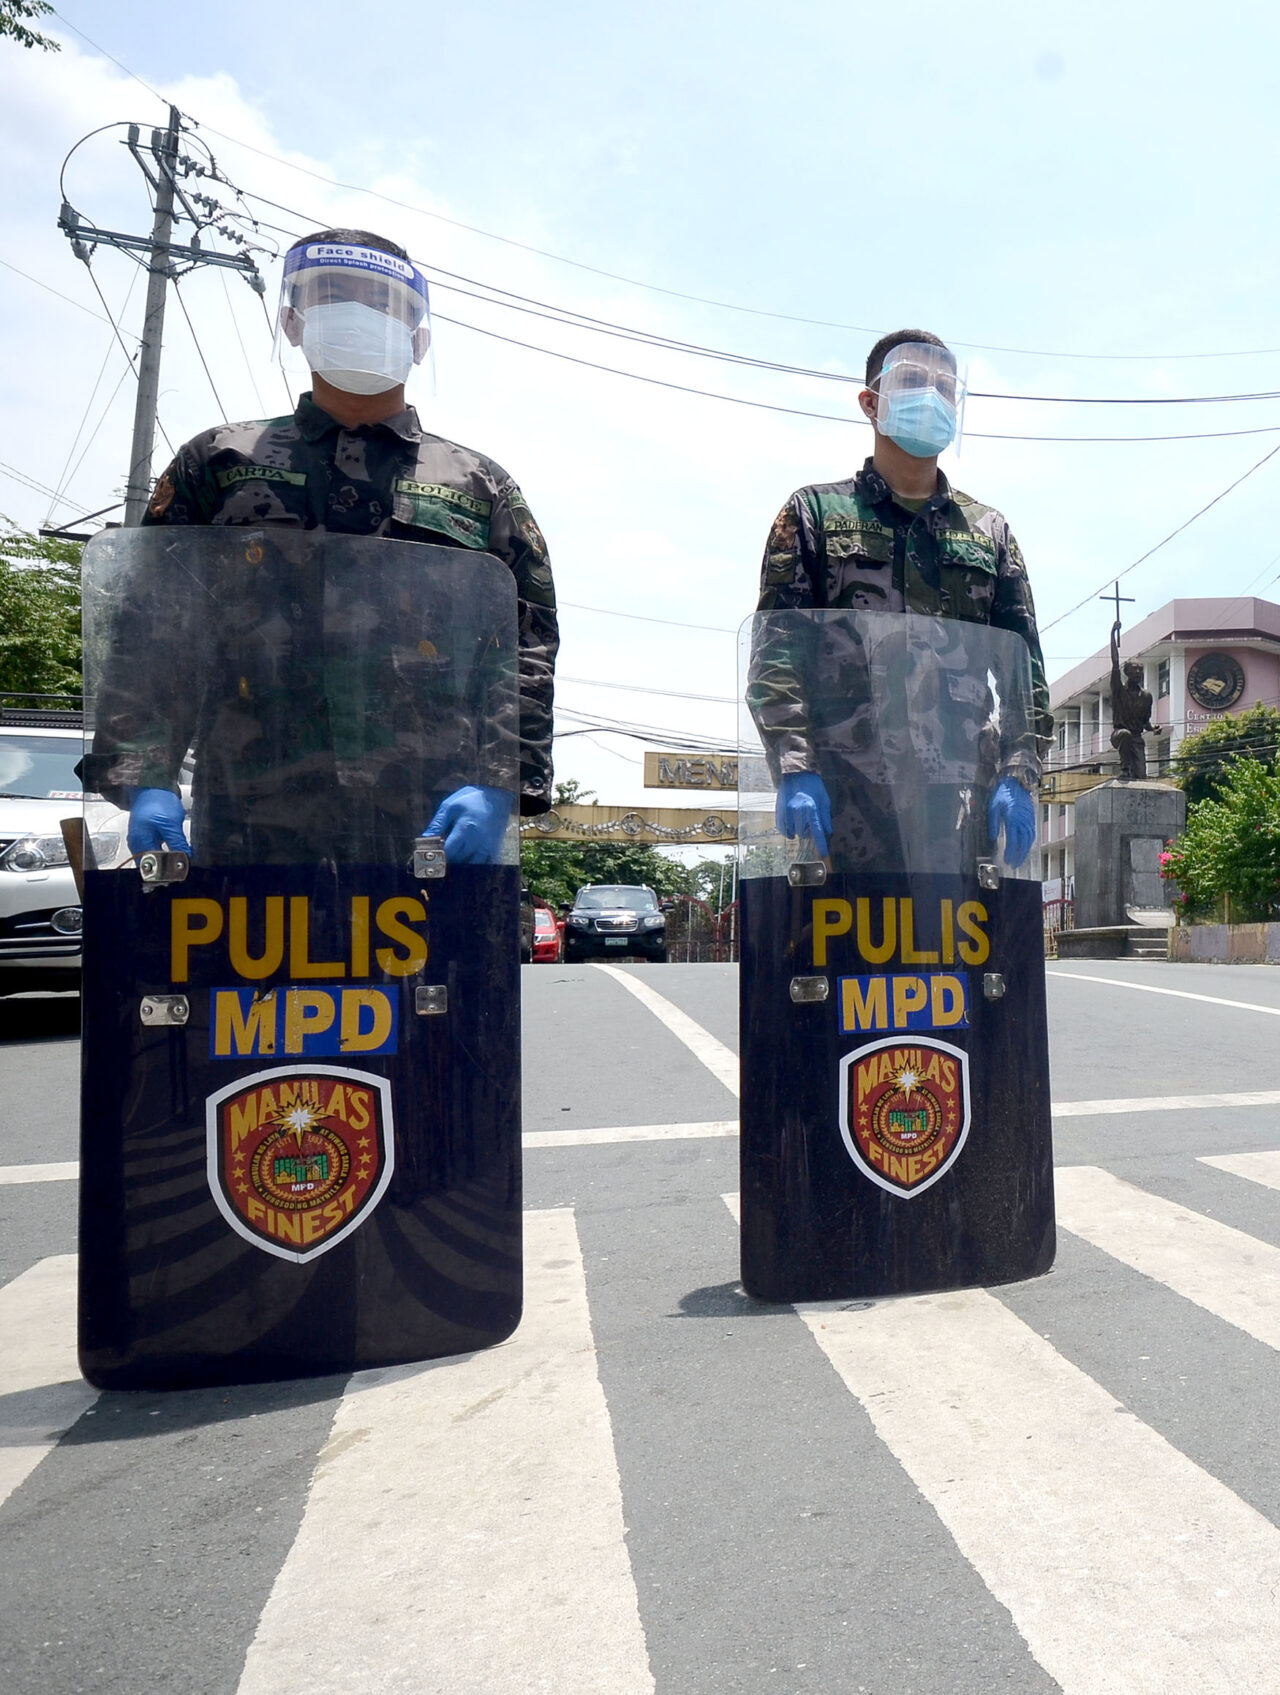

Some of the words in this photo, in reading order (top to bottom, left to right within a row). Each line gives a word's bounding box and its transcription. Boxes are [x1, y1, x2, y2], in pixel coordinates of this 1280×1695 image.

[317, 246, 353, 256] Face
[360, 251, 406, 272] shield
[406, 481, 482, 512] POLICE
[171, 896, 428, 982] PULIS
[812, 897, 990, 967] PULIS
[214, 989, 393, 1056] MPD
[842, 975, 965, 1031] MPD
[857, 1049, 956, 1105] MANILA'S
[230, 1082, 370, 1153] MANILA'S
[291, 1182, 315, 1192] MPD
[868, 1137, 946, 1183] FINEST
[247, 1184, 357, 1244] FINEST
